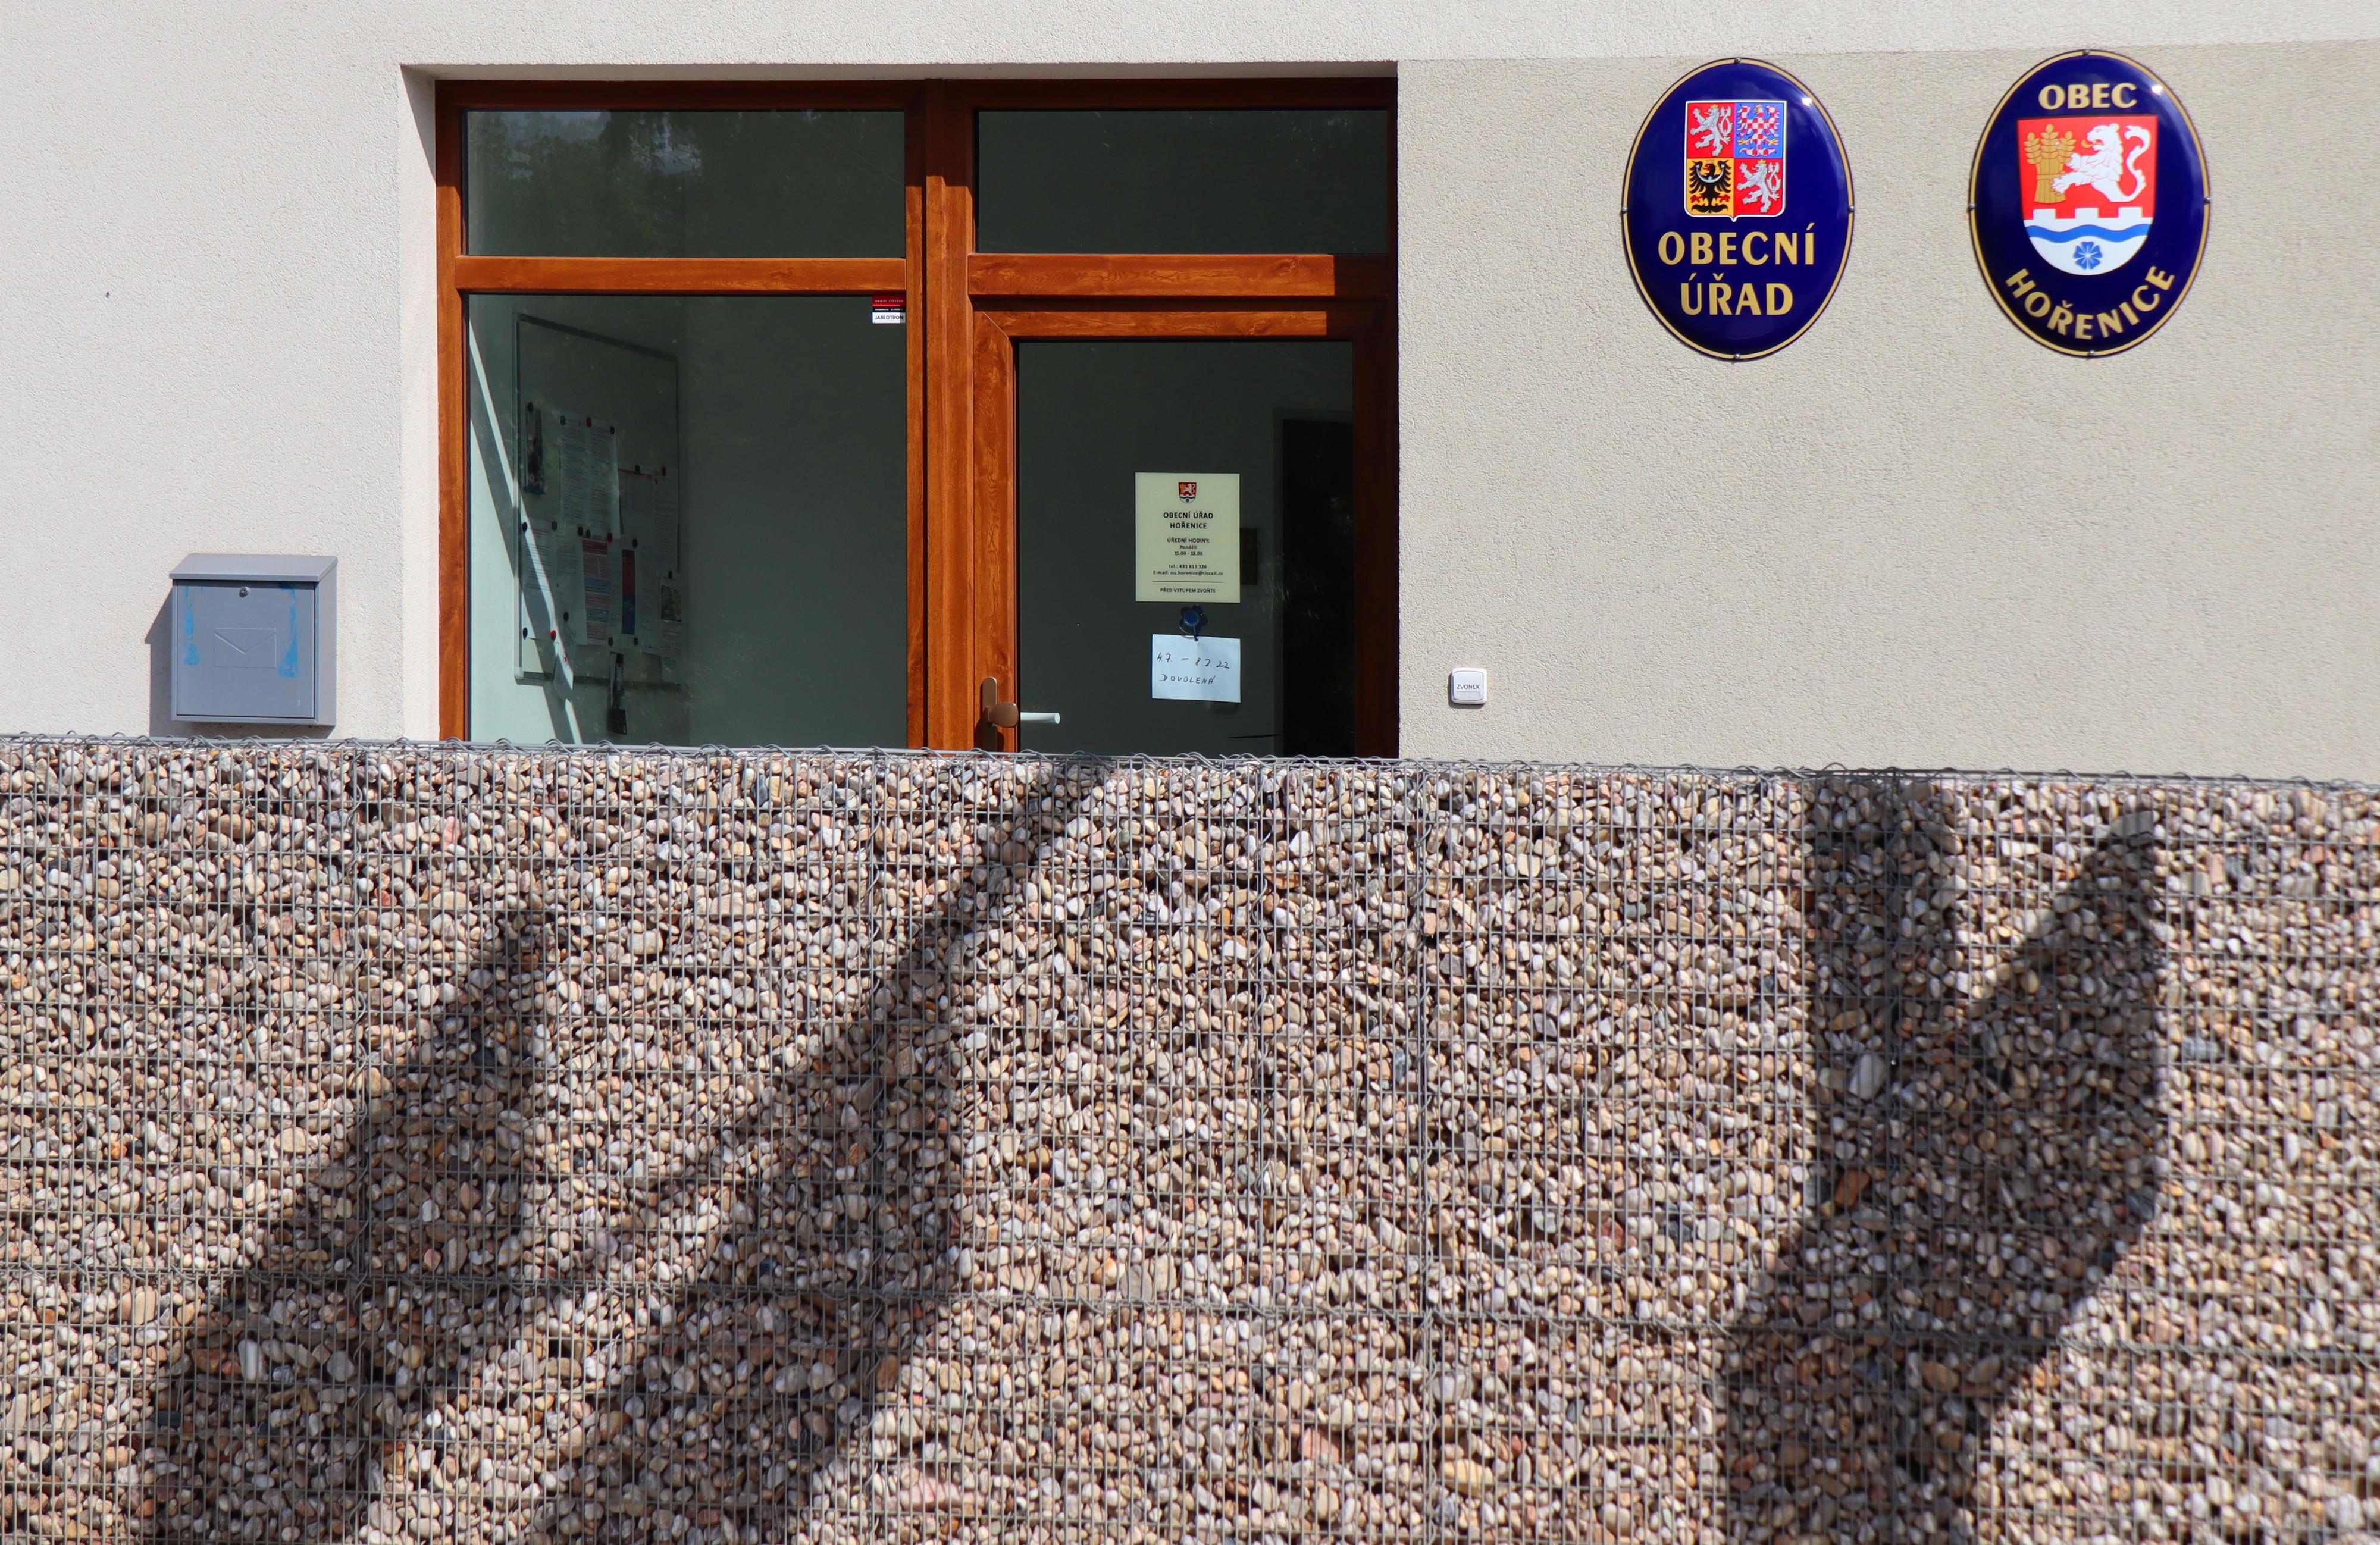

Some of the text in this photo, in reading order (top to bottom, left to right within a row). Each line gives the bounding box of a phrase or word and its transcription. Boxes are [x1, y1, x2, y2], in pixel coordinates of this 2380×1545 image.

[2038, 82, 2137, 110] OBEC
[1658, 222, 1815, 265] OBECNÍ
[1680, 272, 1794, 316] ÚŘAD
[2005, 265, 2175, 340] HOŘENICE
[1159, 674, 1216, 685] DOVOLENÁ
